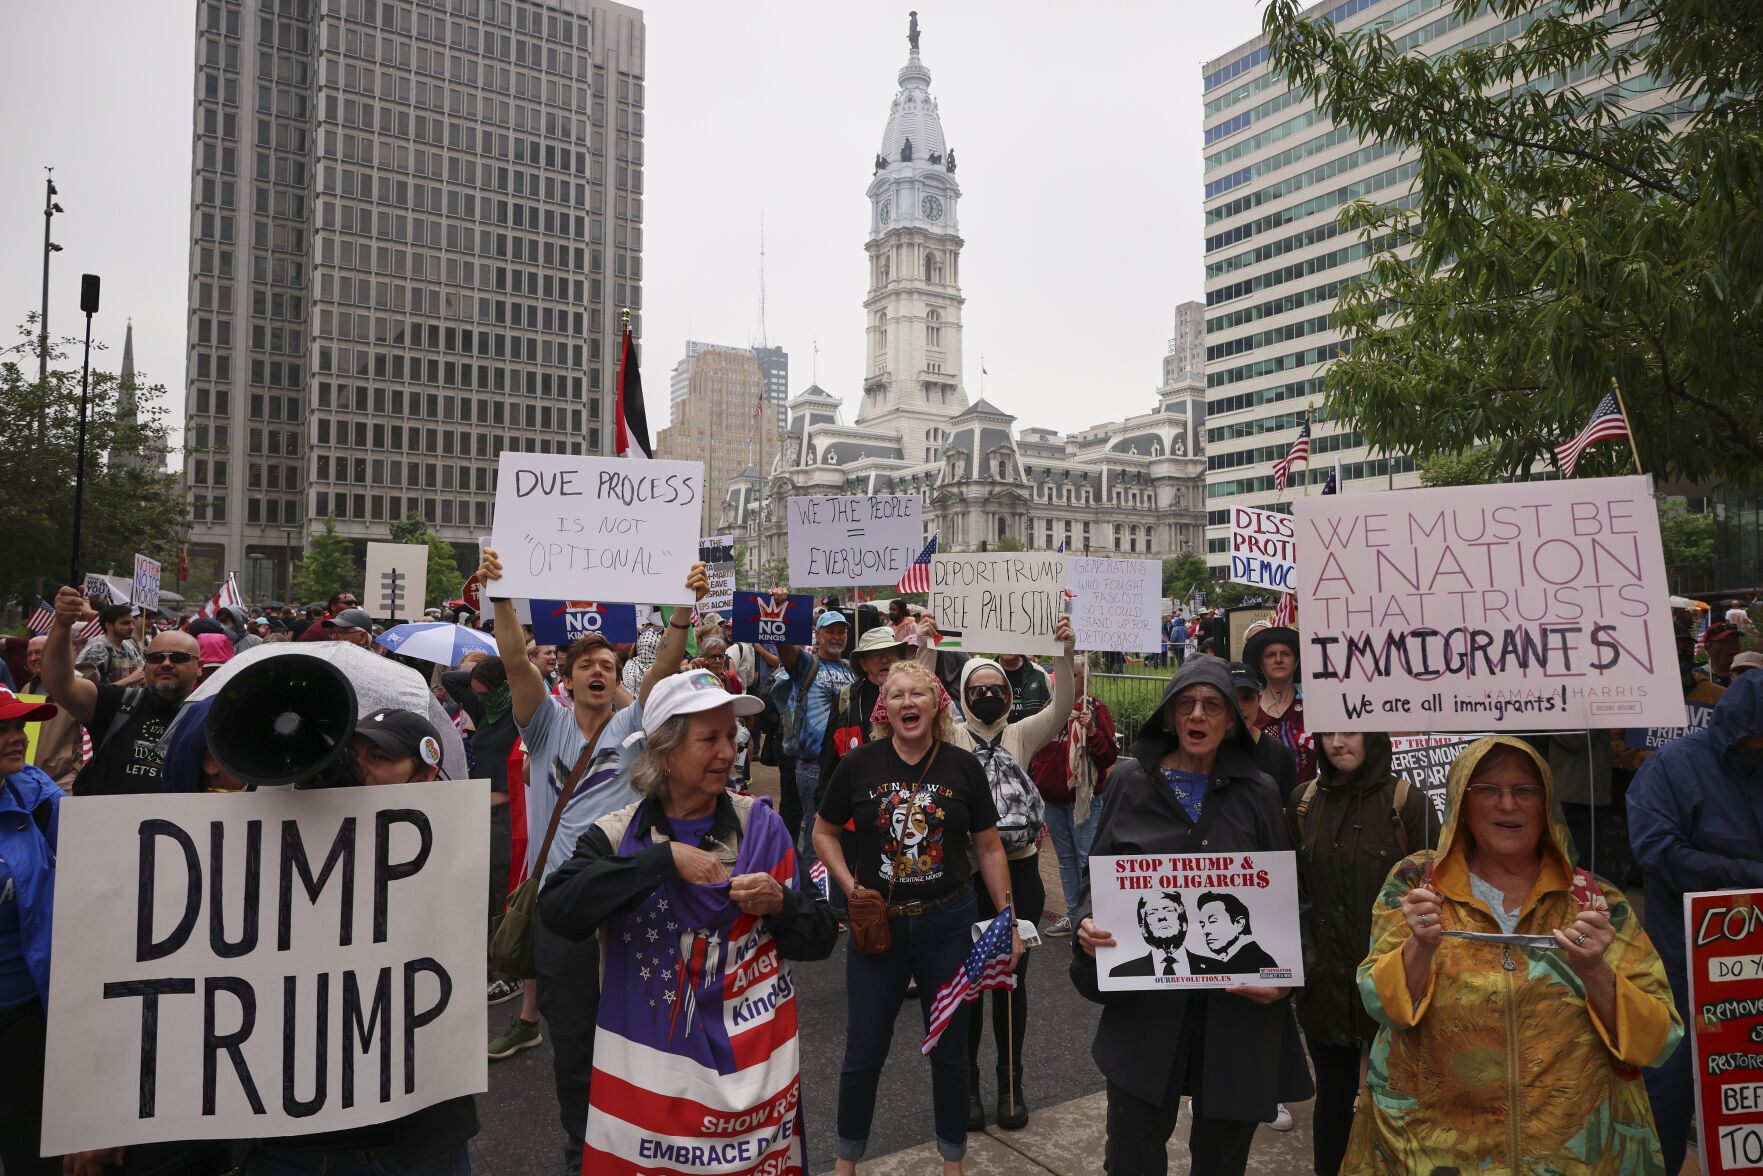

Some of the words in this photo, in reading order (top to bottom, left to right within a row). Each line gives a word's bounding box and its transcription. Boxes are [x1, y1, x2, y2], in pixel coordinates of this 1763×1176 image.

[516, 469, 582, 498] DUE
[598, 471, 695, 506] PROCESS
[794, 499, 821, 525] WE
[826, 498, 860, 522] THE
[868, 497, 912, 520] PEOPLE
[557, 517, 584, 533] IS
[599, 516, 647, 534] NOT
[1310, 514, 1391, 550] WE
[1409, 504, 1552, 545] MUST
[1571, 500, 1638, 536] BE
[709, 539, 723, 547] THE
[524, 534, 672, 576] "OPTIONAL"
[808, 547, 898, 579] EVERYONE
[1313, 551, 1355, 596] A
[1377, 535, 1642, 593] NATION
[935, 561, 998, 586] DEPORT
[1002, 559, 1063, 584] TRUMP
[706, 589, 733, 598] SPANIC
[1079, 579, 1099, 590] WHO
[1104, 579, 1144, 592] FOUGHT
[711, 600, 734, 609] ALONE
[933, 592, 969, 628] FREE
[980, 590, 1064, 636] PALESTINE
[1108, 606, 1142, 617] COULD
[1313, 592, 1435, 629] THAT
[1447, 583, 1650, 624] TRUSTS
[565, 612, 602, 631] NO
[759, 622, 786, 634] NO
[1080, 617, 1112, 629] STAND
[567, 631, 603, 640] KINS
[1311, 625, 1620, 679] IMMIGRANTS
[1342, 693, 1374, 719] We
[1382, 698, 1411, 713] are
[1421, 693, 1442, 713] all
[1454, 685, 1567, 721] immigrants!
[1484, 688, 1561, 700] KAMALA
[1573, 686, 1648, 697] HARRIS
[1406, 737, 1451, 748] TRUMP
[126, 764, 157, 777] LET'S
[869, 782, 908, 799] LATINA
[1116, 859, 1163, 873] STOP
[1169, 857, 1234, 872] TRUMP
[1241, 856, 1254, 870] &
[136, 808, 432, 962] DUMP
[1117, 875, 1153, 890] THE
[1159, 870, 1270, 889] OLIGARCH$
[1719, 960, 1743, 977] DO
[1750, 955, 1763, 975] Y
[103, 957, 452, 1118] TRUMP
[701, 1107, 769, 1133] SHOW
[639, 1137, 751, 1167] EMBRACE
